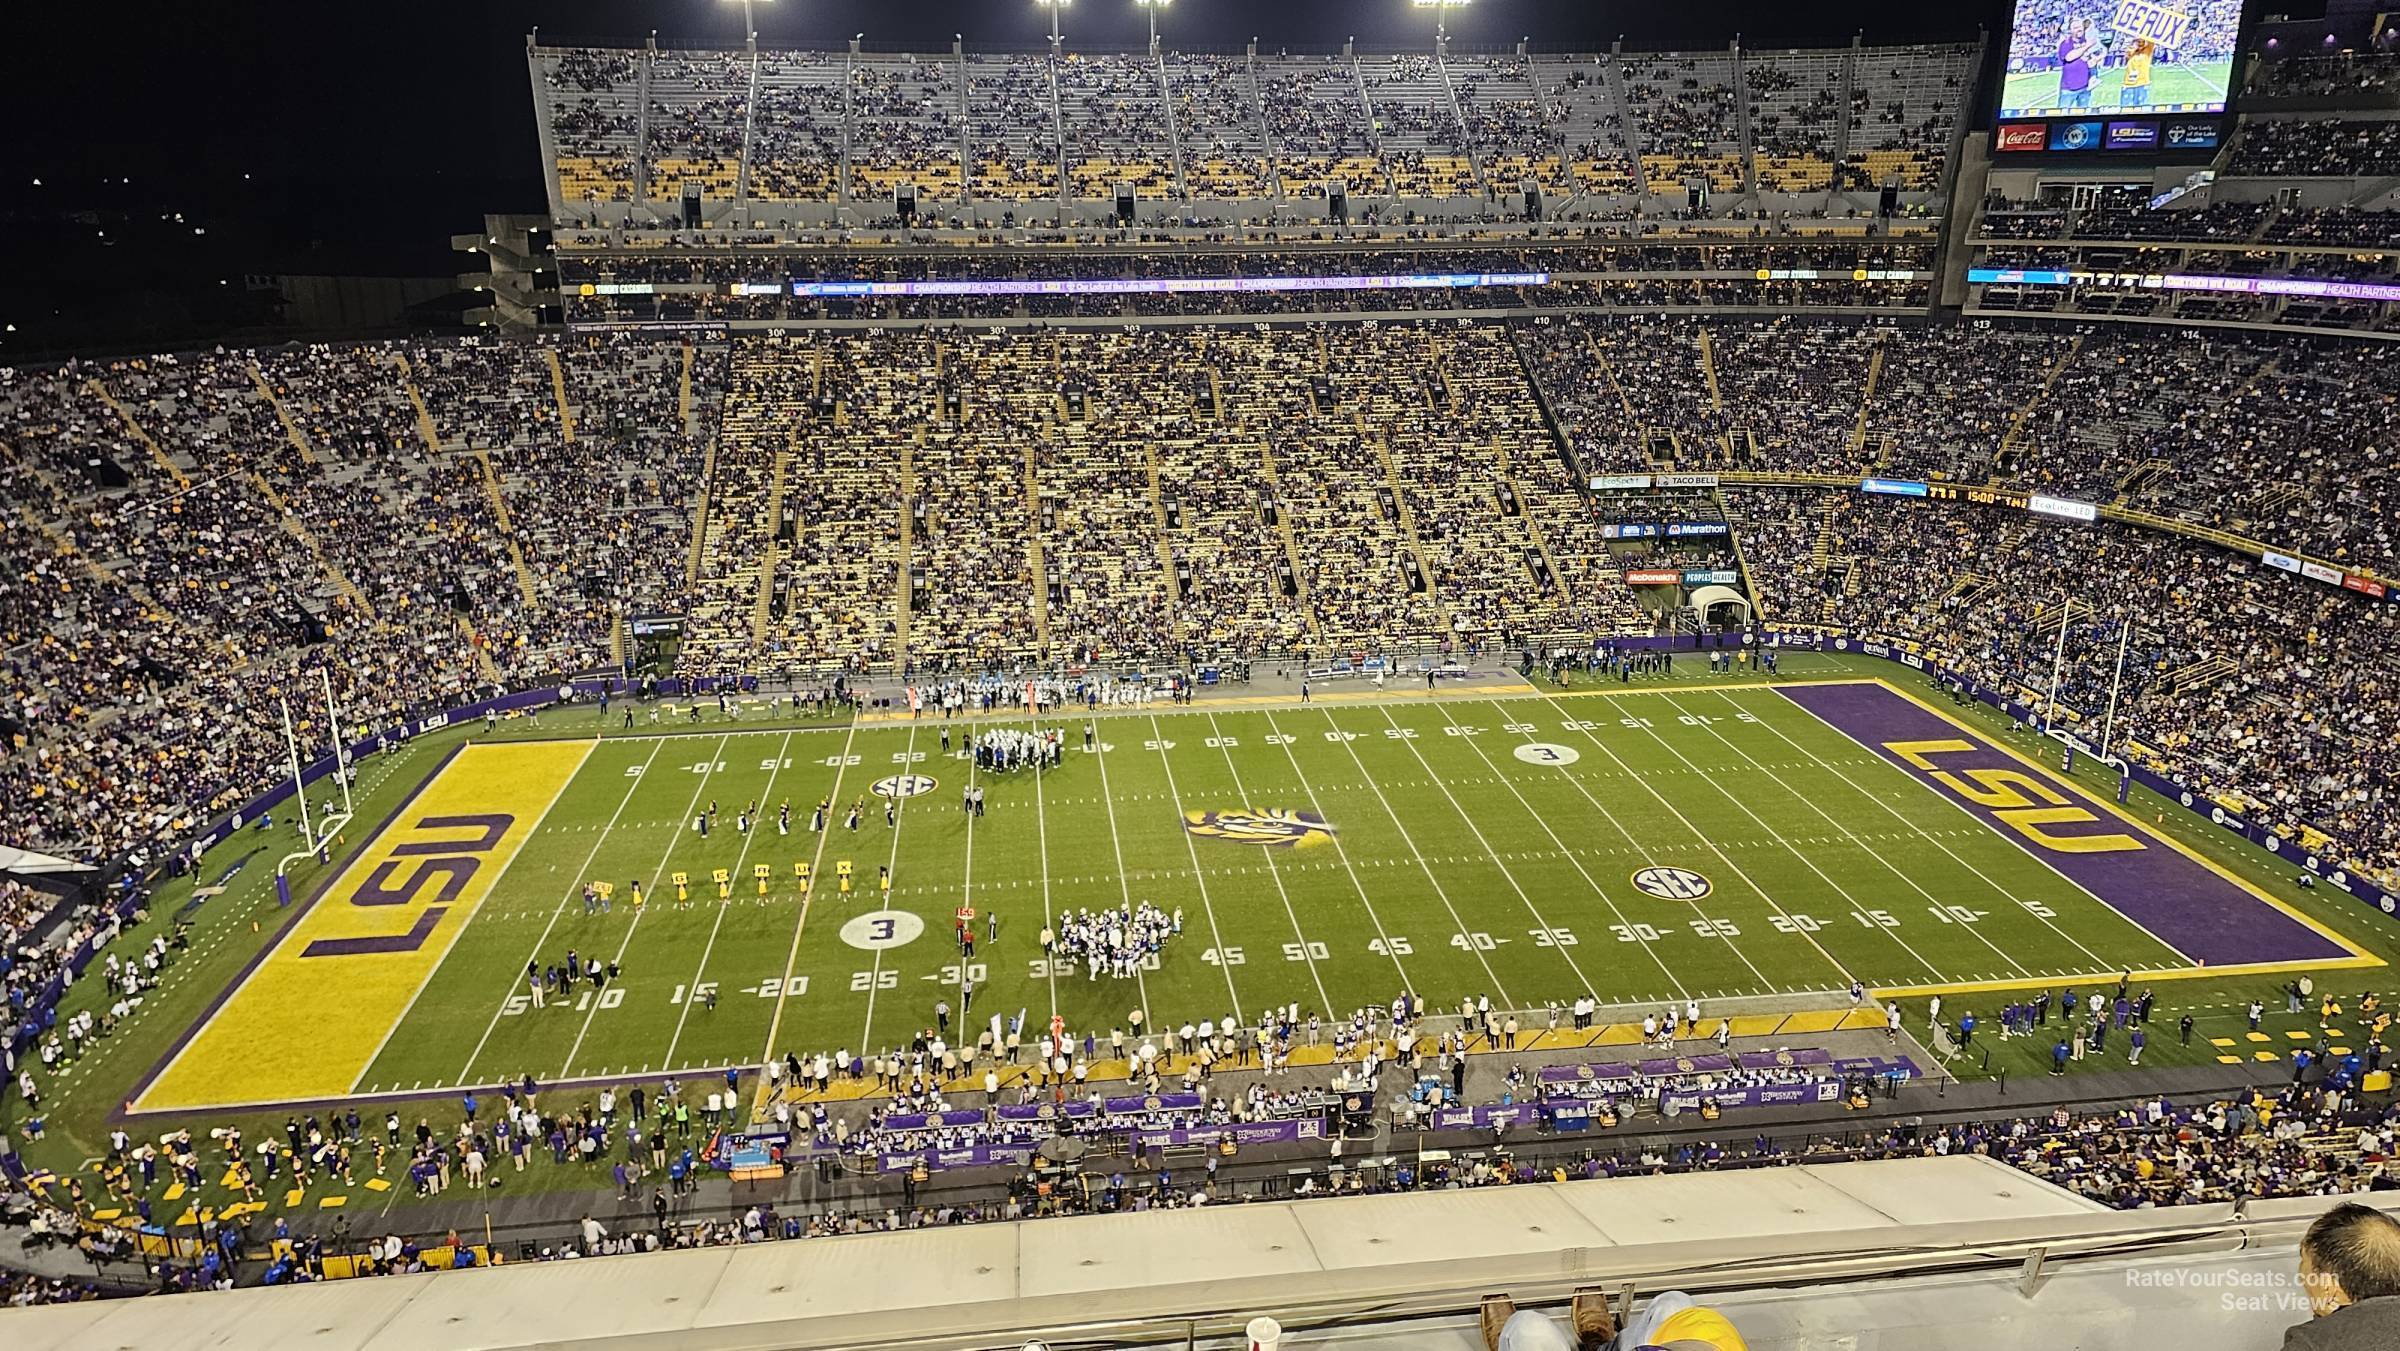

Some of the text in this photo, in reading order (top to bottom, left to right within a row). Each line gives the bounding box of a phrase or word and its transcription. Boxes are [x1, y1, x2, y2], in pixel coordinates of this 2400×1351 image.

[2117, 2, 2185, 45] GEAUX
[2112, 128, 2134, 137] LSU
[914, 282, 971, 292] CHAMPIONSHIP
[972, 282, 999, 292] HEALTH
[1000, 281, 1038, 291] PARTNERS
[1297, 279, 1323, 287] HEALTH
[1325, 278, 1359, 287] PARTNERS
[2327, 285, 2360, 295] HEALTH
[1253, 322, 1270, 331] 304
[1361, 320, 1378, 329] 305
[1534, 316, 1550, 325] 410
[767, 329, 785, 337] 300
[868, 327, 884, 336] 301
[990, 326, 1006, 335] 302
[459, 336, 480, 347] 242
[1695, 476, 1716, 484] BELL
[1967, 490, 1995, 504] 15:00
[1681, 524, 1727, 534] Marathon
[1628, 573, 1677, 581] McDonald's
[1686, 572, 1735, 582] PEOPLES HEALTH
[1900, 652, 1923, 669] LSU
[418, 713, 448, 733] LSU
[1620, 718, 1654, 729] 15
[1677, 715, 1714, 726] 10
[1736, 713, 1758, 723] 5
[1443, 726, 1480, 737] 30
[1503, 723, 1538, 734] 25
[1561, 721, 1599, 732] 20
[1265, 734, 1297, 745] 45
[1324, 731, 1359, 742] 40
[1383, 729, 1420, 739] 35
[1144, 740, 1177, 751] 45
[1204, 737, 1239, 747] 50
[826, 754, 862, 766] 20
[892, 752, 926, 763] 25
[1532, 748, 1559, 761] 3
[692, 761, 727, 774] 10
[760, 758, 793, 770] 15
[624, 765, 645, 777] 5
[876, 776, 933, 798] SEC
[1881, 739, 2149, 853] LSU
[298, 813, 516, 959] LSU
[1637, 868, 1710, 899] SEC
[1927, 905, 1981, 923] 10
[2023, 901, 2058, 918] 5
[1767, 915, 1822, 933] 20
[1850, 910, 1901, 928] 15
[868, 918, 896, 941] 3
[1609, 924, 1662, 942] 30
[1688, 919, 1742, 937] 25
[1450, 933, 1497, 951] 40
[1528, 928, 1579, 947] 35
[1281, 942, 1330, 961] 50
[1367, 937, 1415, 956] 45
[1200, 947, 1247, 966] 45
[940, 964, 987, 985] 30
[1028, 958, 1075, 979] 35
[758, 976, 810, 998] 20
[850, 970, 899, 992] 25
[575, 988, 627, 1011] 10
[670, 982, 719, 1005] 15
[503, 995, 532, 1016] 5
